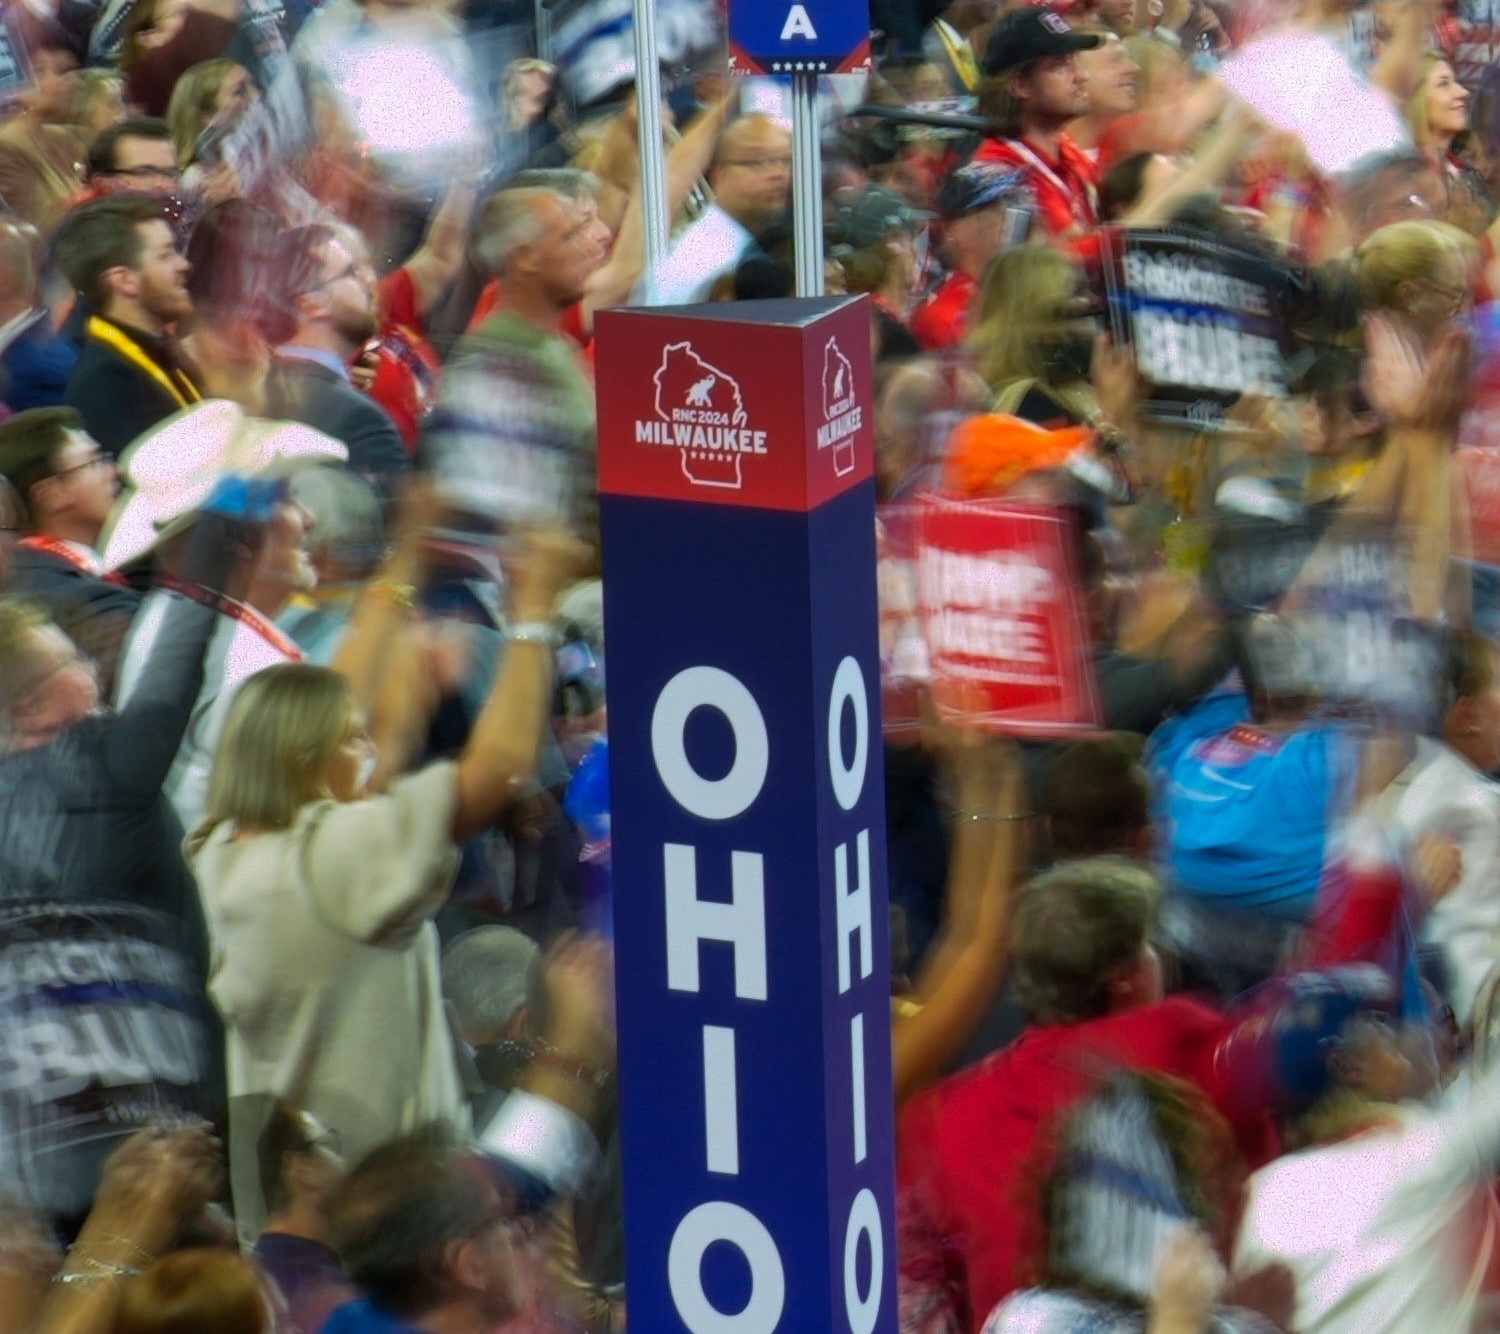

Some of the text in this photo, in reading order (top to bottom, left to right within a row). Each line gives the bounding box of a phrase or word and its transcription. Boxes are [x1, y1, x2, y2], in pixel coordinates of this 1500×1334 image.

[672, 409, 728, 426] RNC 2024
[635, 419, 768, 454] MILWAUKEE
